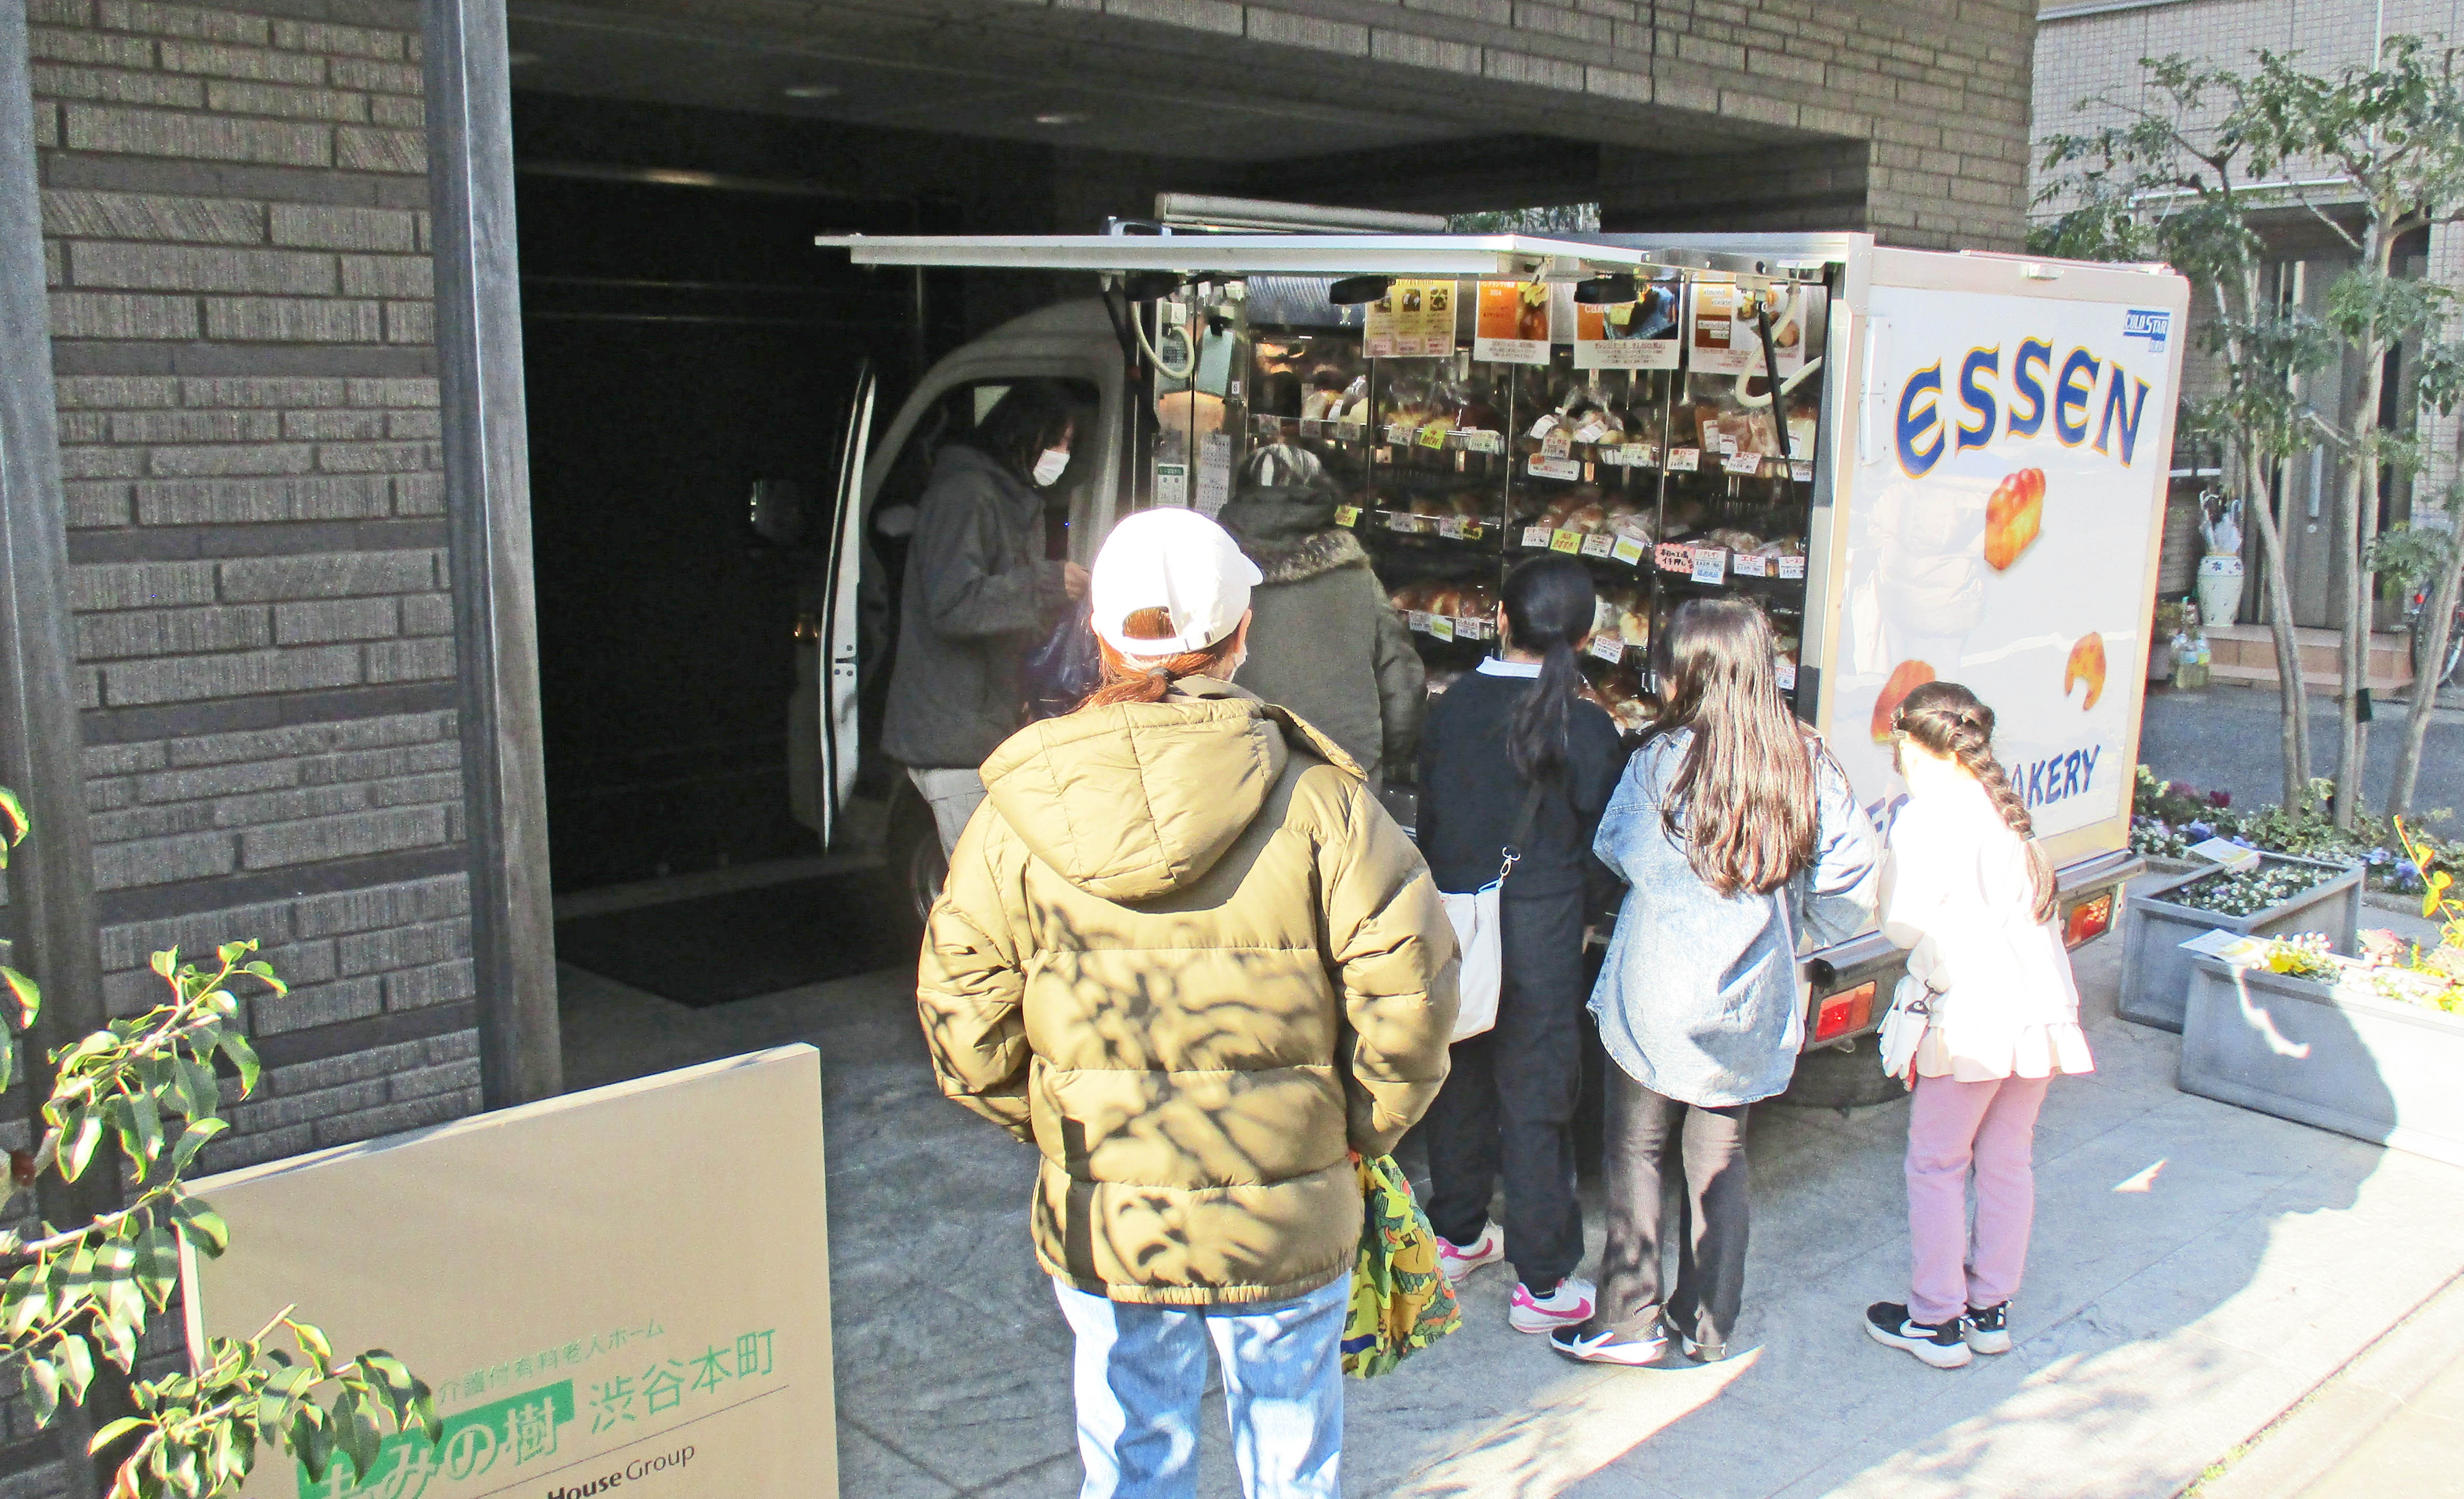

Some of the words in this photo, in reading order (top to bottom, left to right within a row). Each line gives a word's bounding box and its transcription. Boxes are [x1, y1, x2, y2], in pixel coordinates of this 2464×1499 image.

[1894, 337, 2151, 479] ESSEN
[2004, 745, 2101, 809] AKERY
[439, 1318, 664, 1406] 介護付有料老人ホーム
[589, 1328, 776, 1434] 渋谷本町
[547, 1472, 622, 1499] House
[626, 1446, 696, 1480] Group
